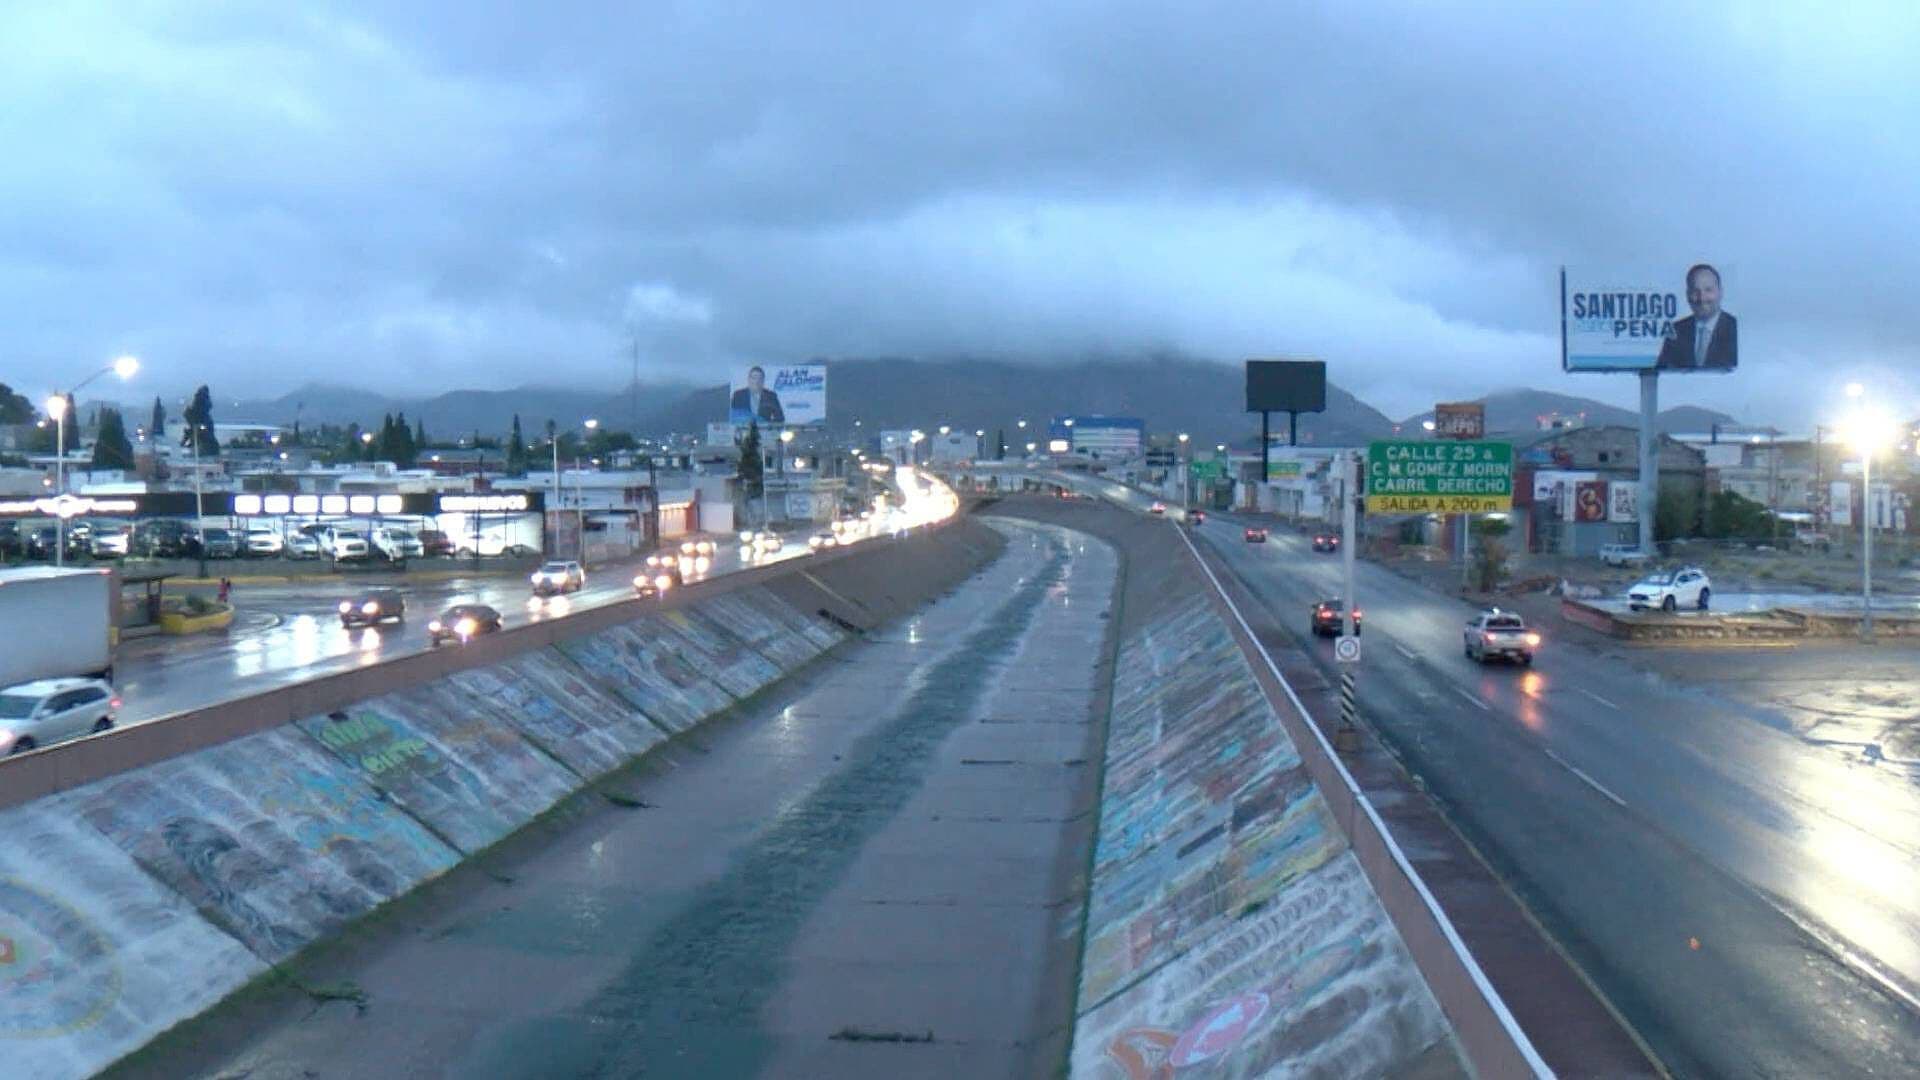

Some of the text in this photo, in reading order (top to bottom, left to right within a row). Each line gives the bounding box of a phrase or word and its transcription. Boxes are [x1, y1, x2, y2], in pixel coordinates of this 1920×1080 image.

[1573, 293, 1677, 319] SANTIAGO
[1386, 446, 1446, 460] CALLE
[1375, 478, 1506, 492] CARRIL DERECHO
[1380, 497, 1428, 511] SALIDA
[1436, 498, 1447, 511] A
[1451, 497, 1480, 511] 200
